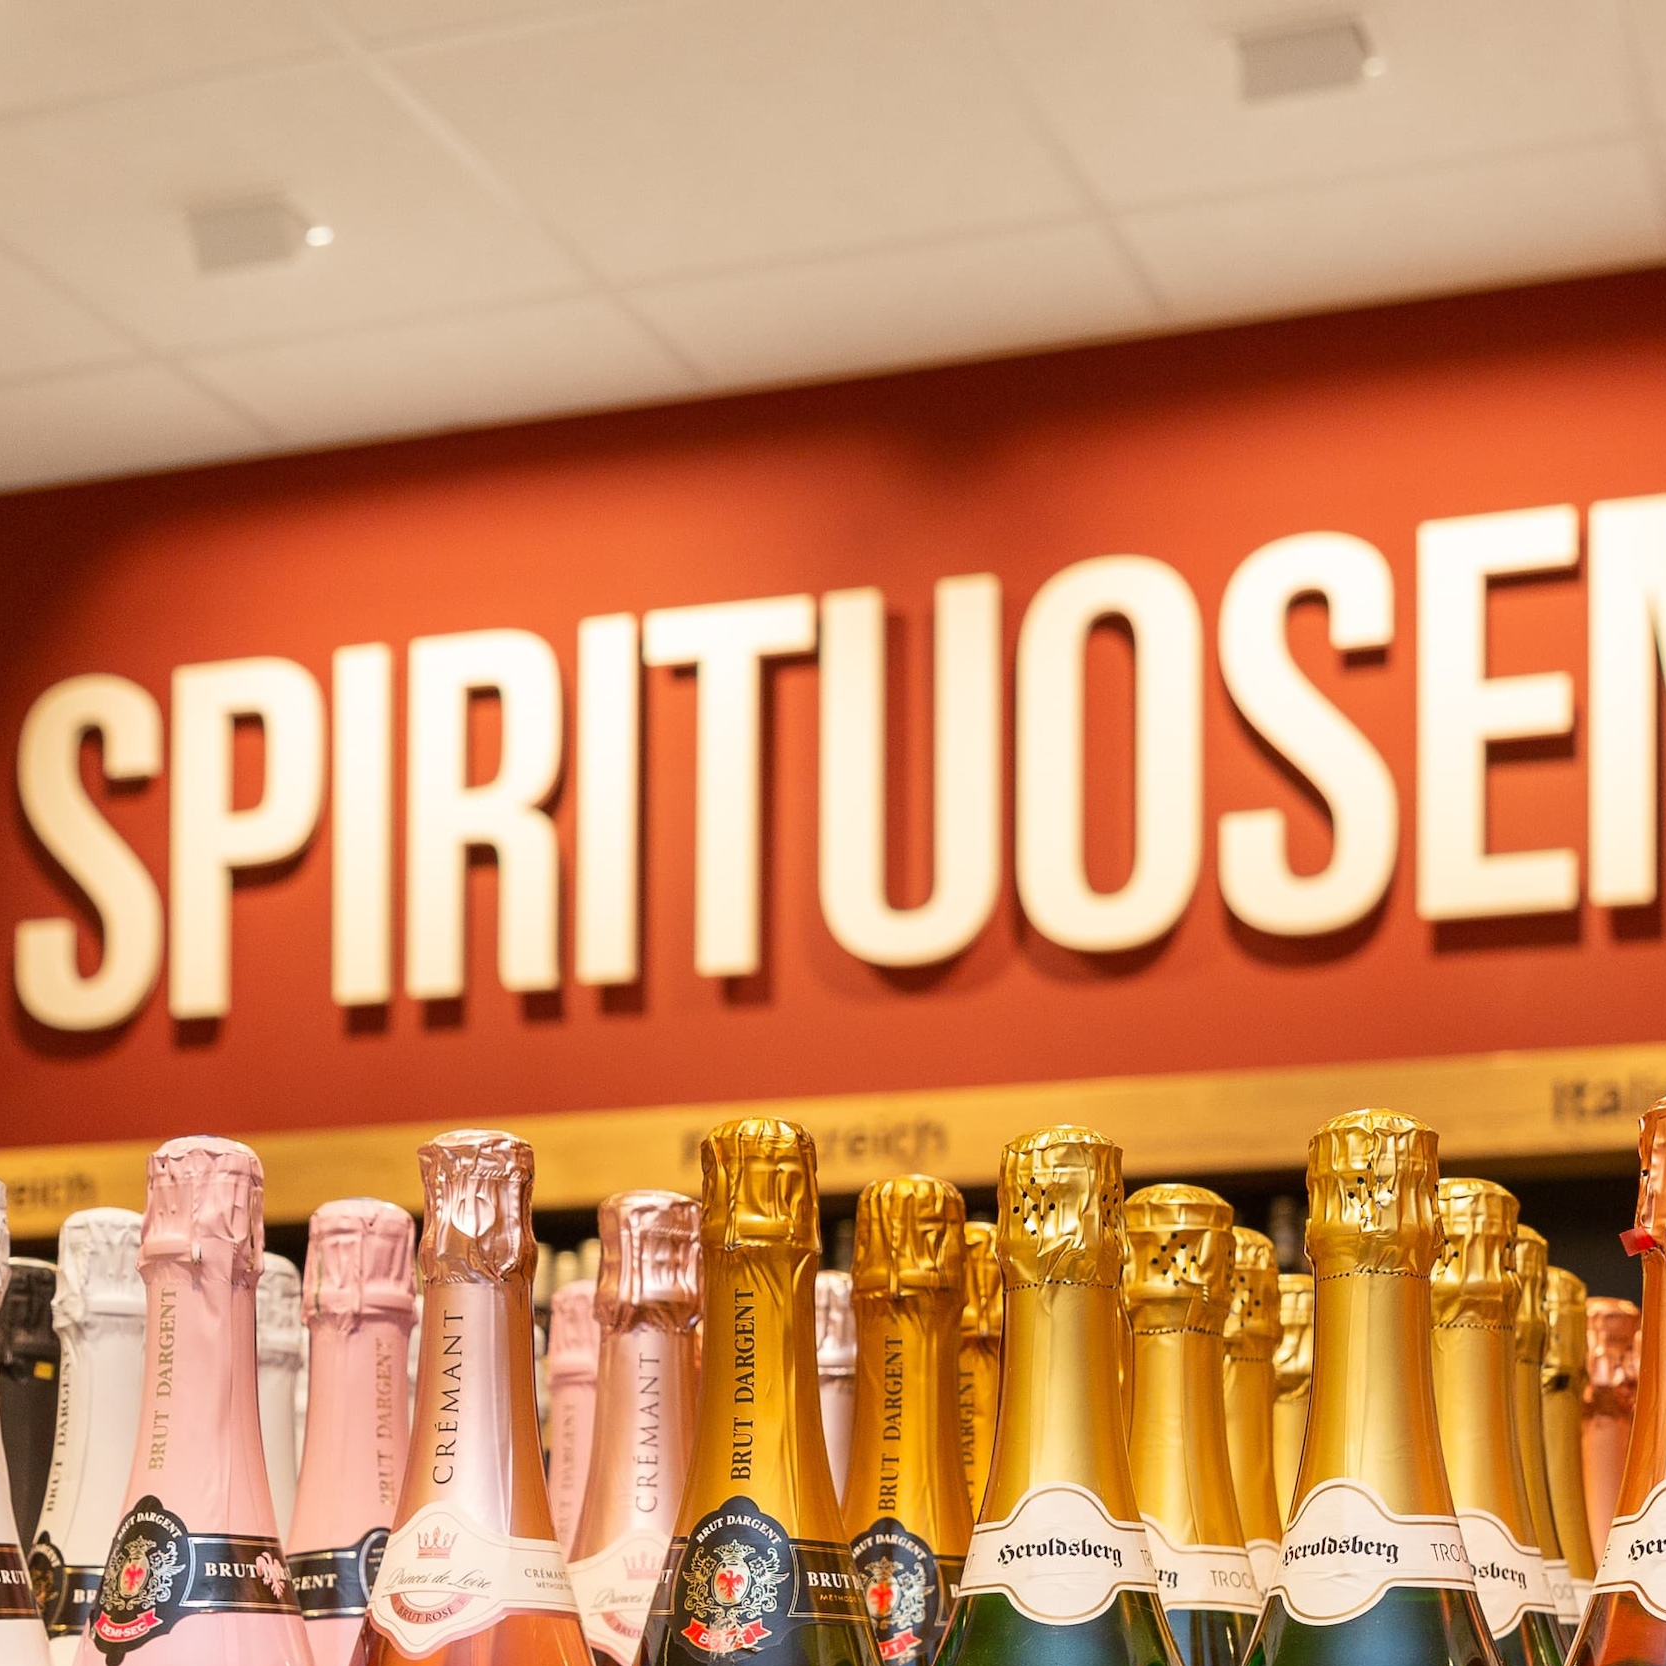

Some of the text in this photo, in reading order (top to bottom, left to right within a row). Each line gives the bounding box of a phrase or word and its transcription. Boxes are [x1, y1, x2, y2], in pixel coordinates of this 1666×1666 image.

[147, 1287, 179, 1472] BRUT DARGENT
[431, 1309, 465, 1486] CRÉMANT
[730, 1287, 757, 1482] BRUT DARGENT
[997, 1541, 1122, 1569] Heroldsberg
